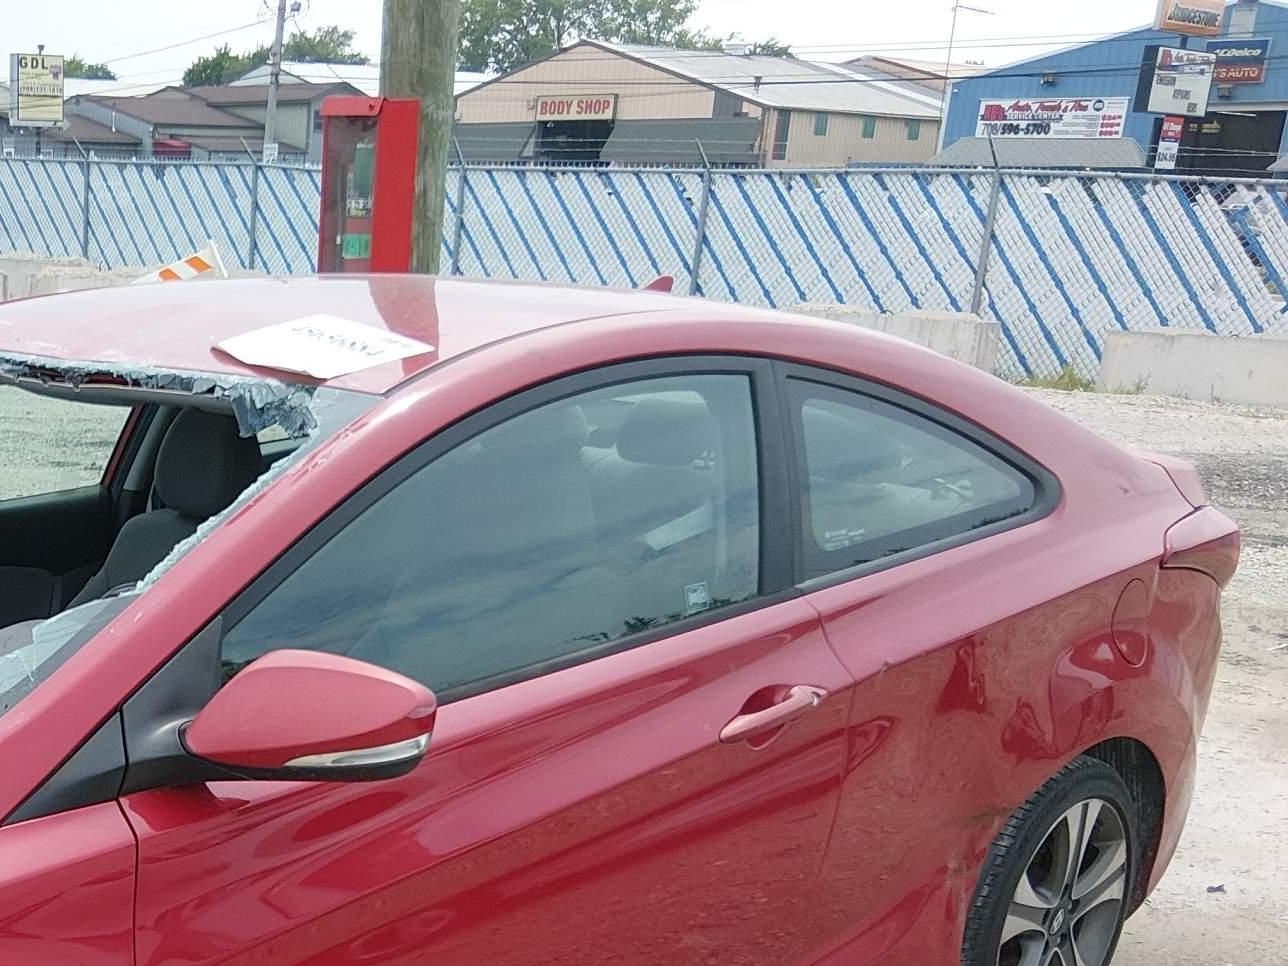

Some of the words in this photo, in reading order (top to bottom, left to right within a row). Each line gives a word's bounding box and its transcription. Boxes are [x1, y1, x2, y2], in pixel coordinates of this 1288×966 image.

[19, 56, 49, 69] GDL
[1227, 67, 1259, 78] AUTO
[540, 100, 573, 115] BODY
[576, 99, 611, 115] SHOP
[1006, 112, 1032, 121] SERVICE
[1034, 112, 1062, 121] CENTER
